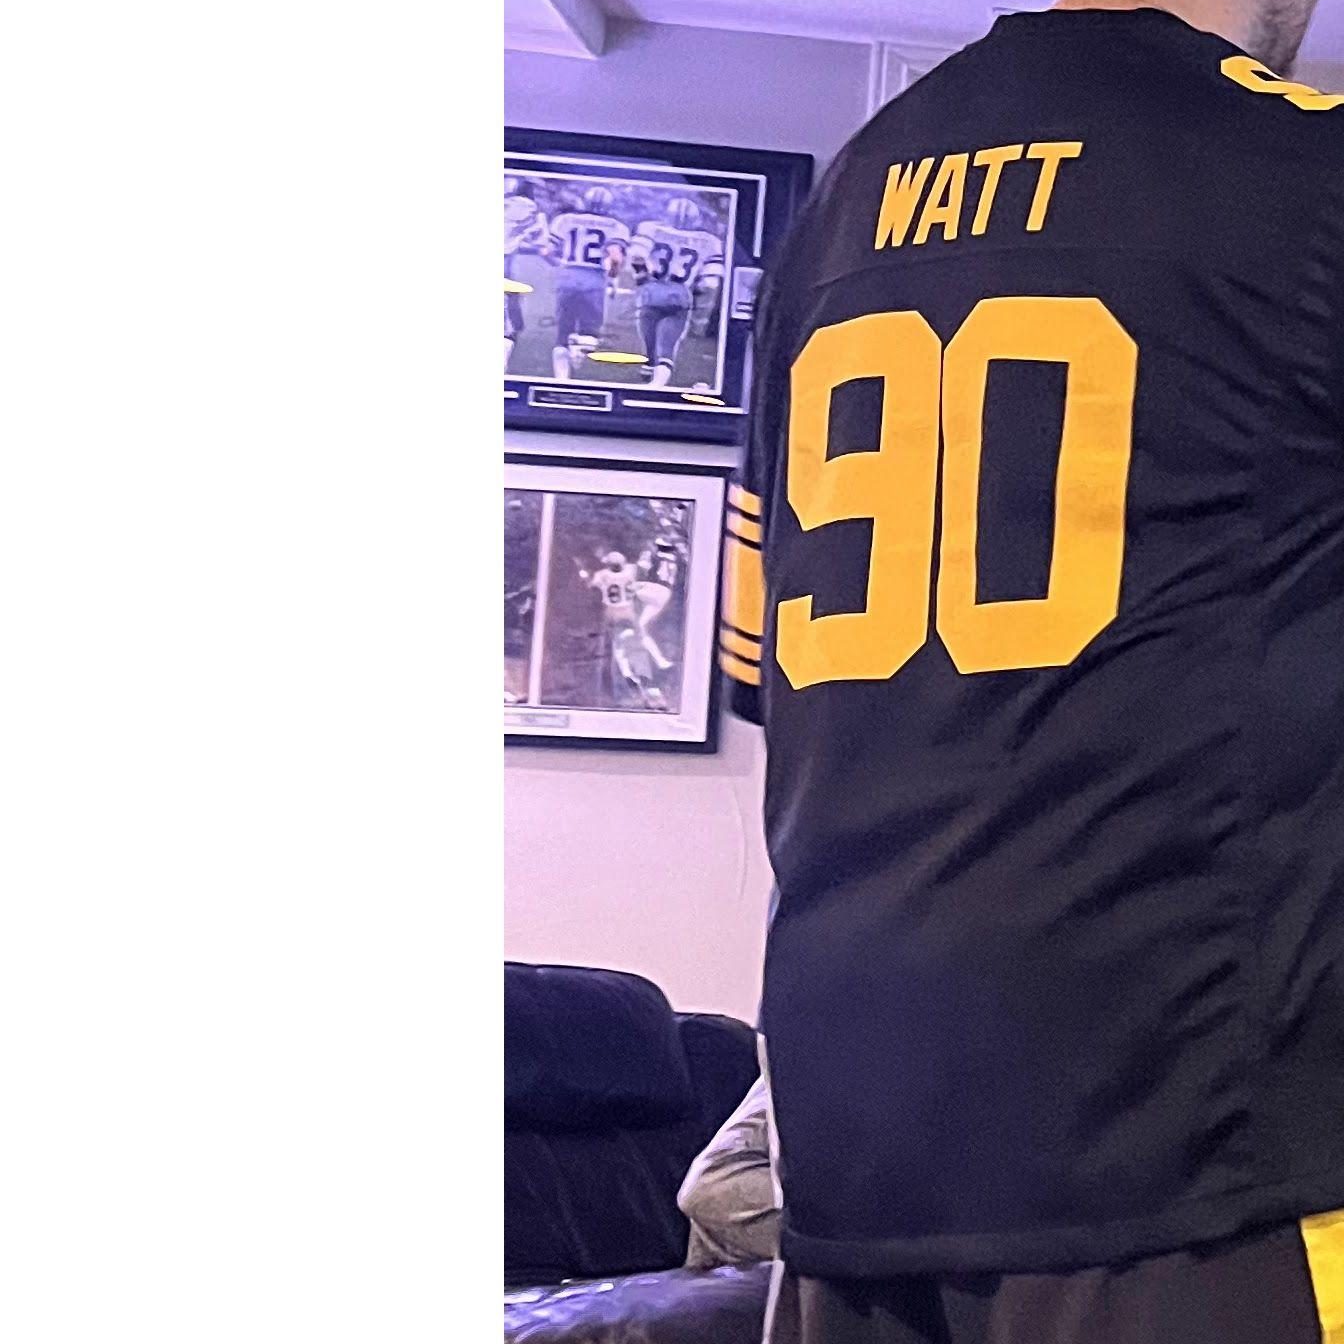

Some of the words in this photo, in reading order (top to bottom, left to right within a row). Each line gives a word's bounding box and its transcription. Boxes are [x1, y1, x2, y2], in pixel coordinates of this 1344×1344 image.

[874, 141, 1083, 251] WATT
[567, 227, 606, 265] 12
[650, 242, 699, 284] 33
[776, 296, 1139, 690] 90
